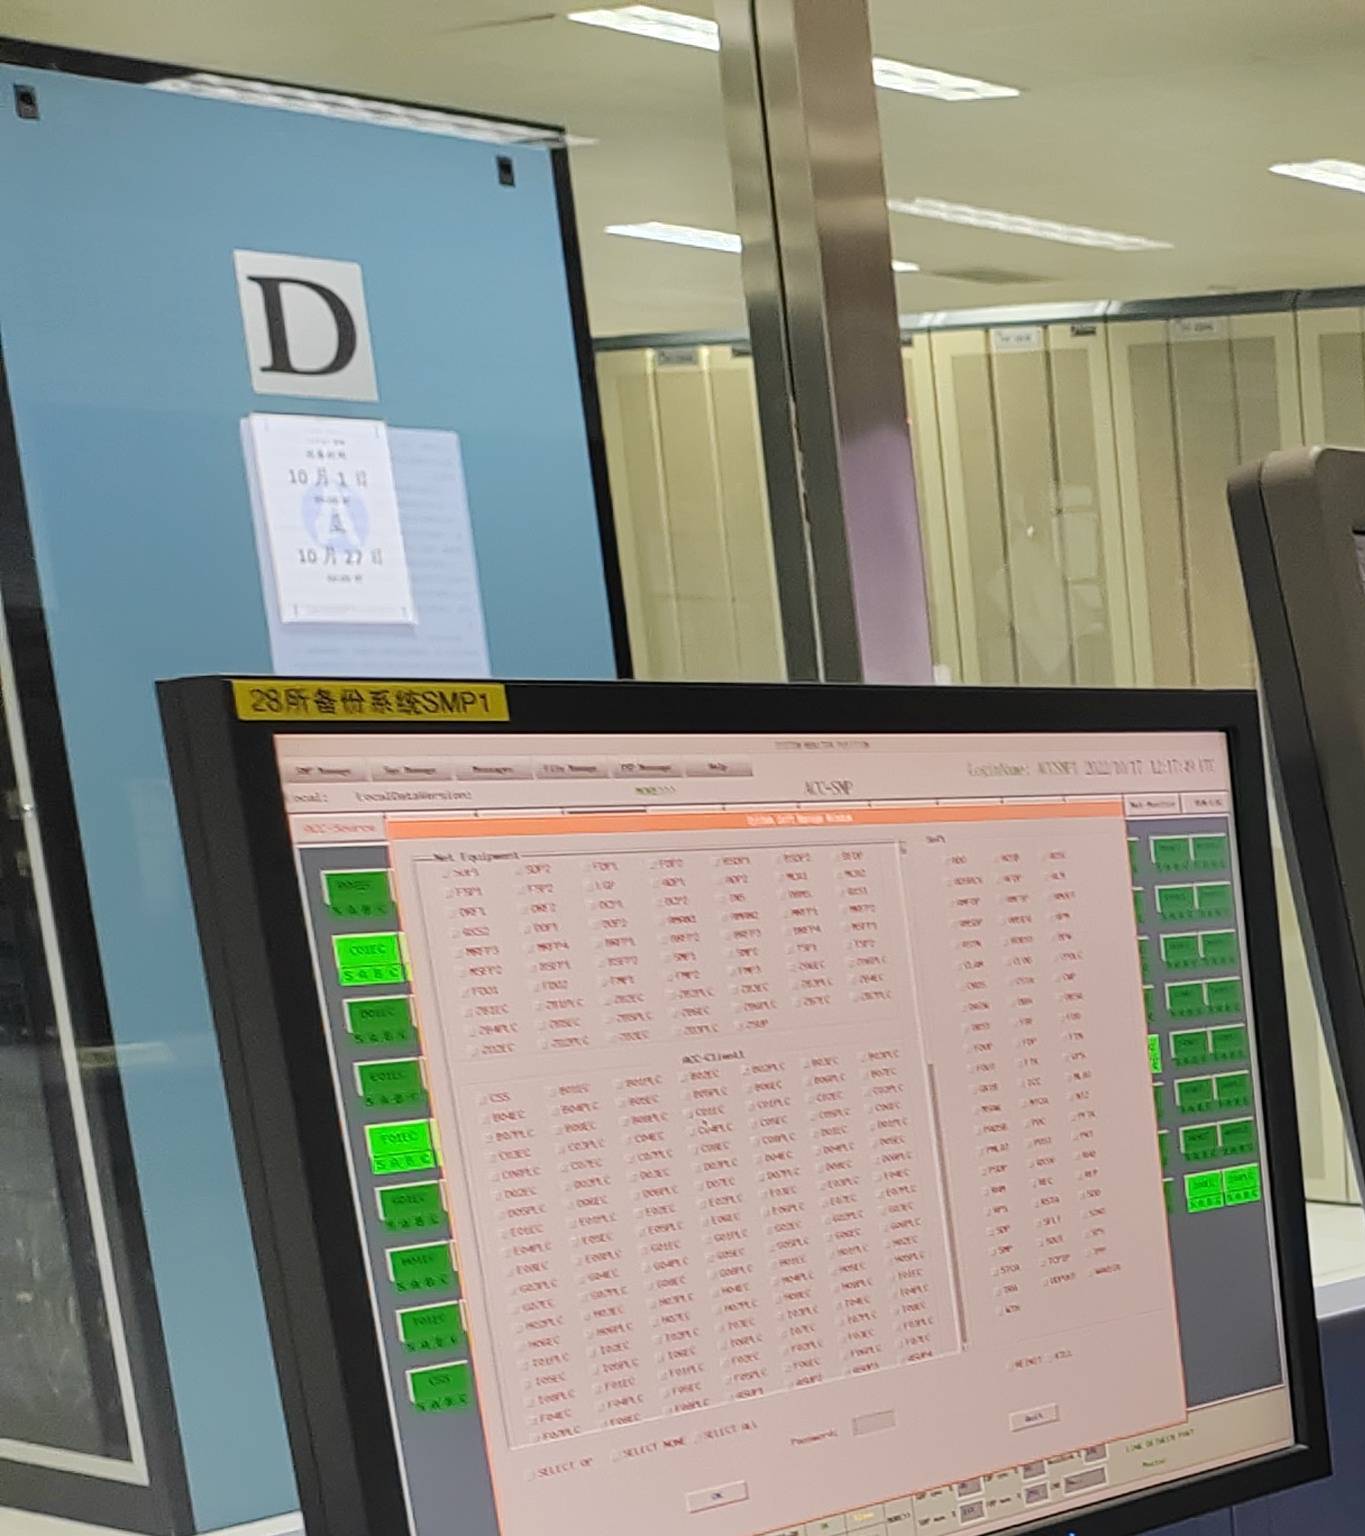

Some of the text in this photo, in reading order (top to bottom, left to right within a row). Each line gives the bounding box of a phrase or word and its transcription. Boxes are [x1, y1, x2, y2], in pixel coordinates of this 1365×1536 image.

[248, 275, 357, 377] D
[289, 468, 308, 485] 10
[299, 549, 317, 565] 10
[345, 549, 363, 565] 27
[250, 687, 490, 715] 28所备份系统SMP1
